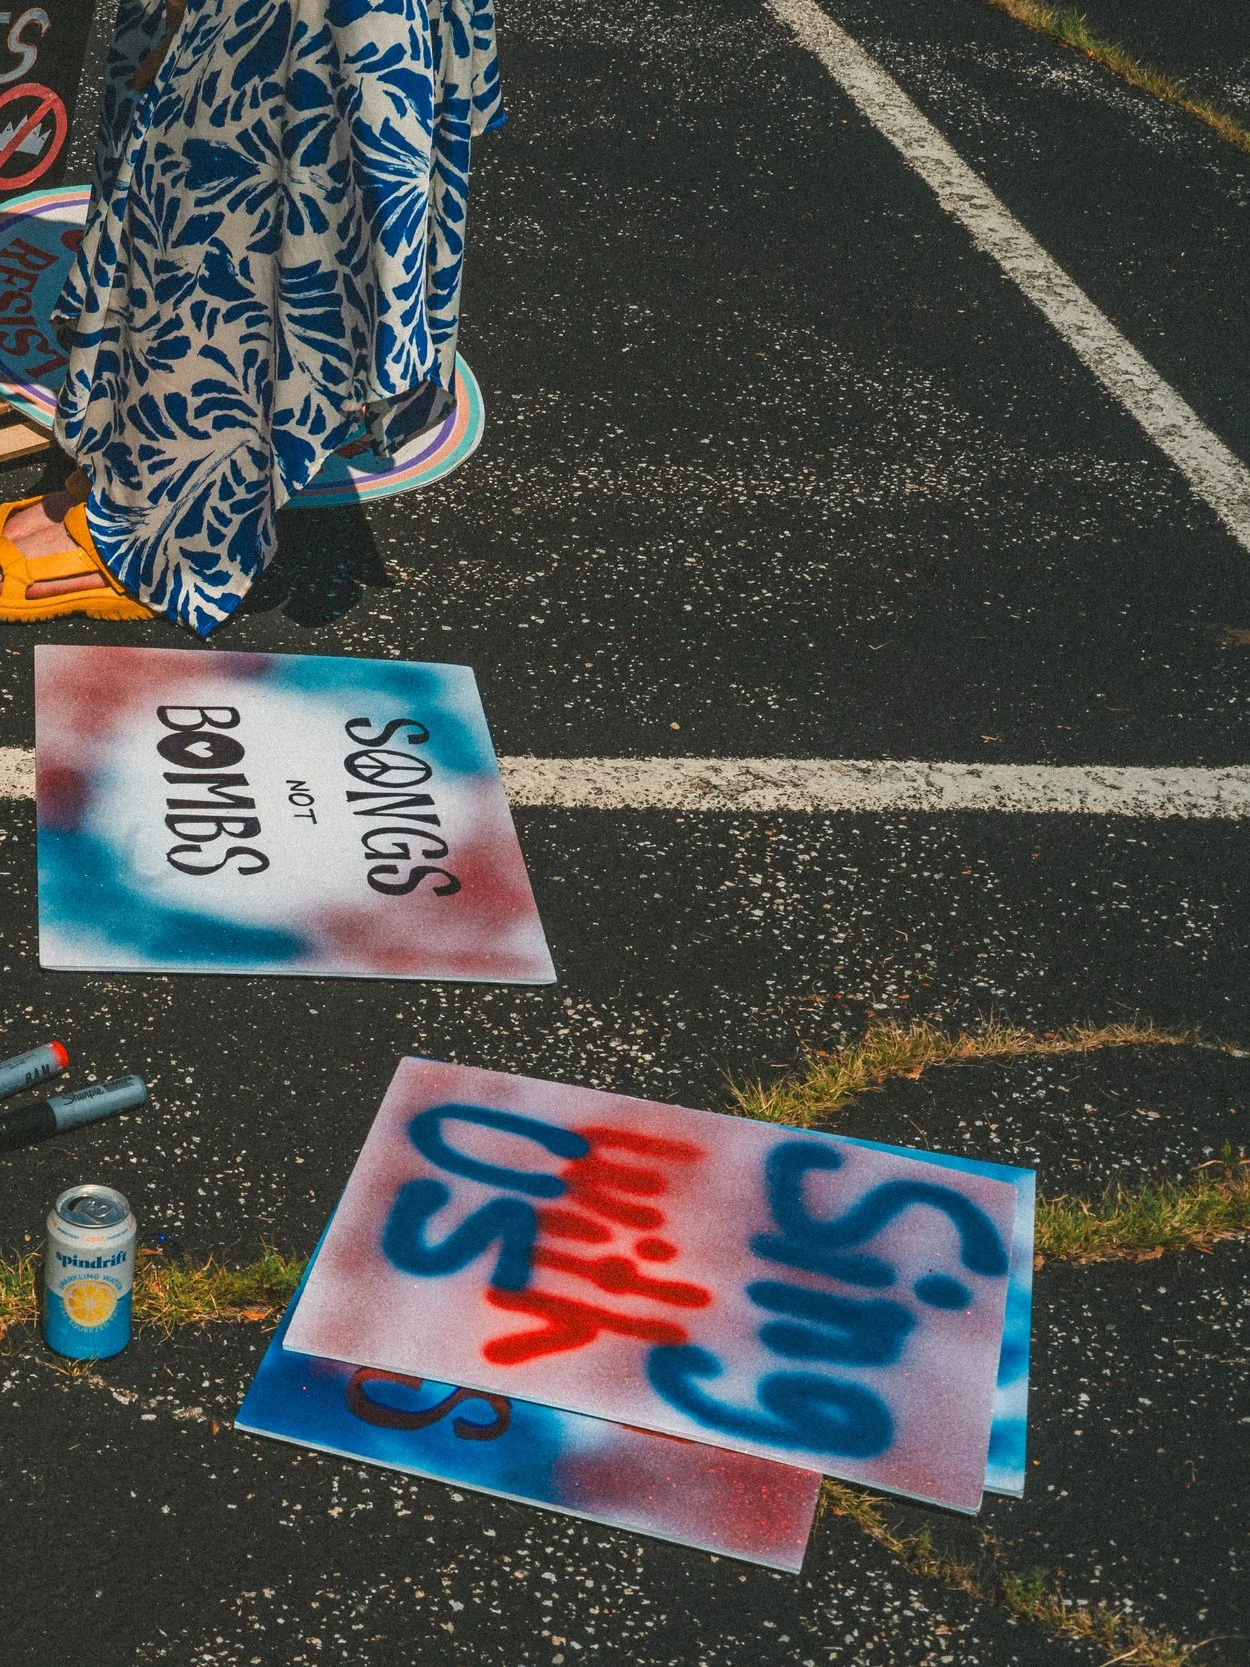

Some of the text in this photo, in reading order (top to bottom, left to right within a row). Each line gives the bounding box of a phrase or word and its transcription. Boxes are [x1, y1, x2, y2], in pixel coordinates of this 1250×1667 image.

[155, 705, 270, 877] BOMBS
[285, 780, 318, 826] NOT
[343, 716, 462, 897] SONGS
[645, 1138, 1011, 1459] Sing
